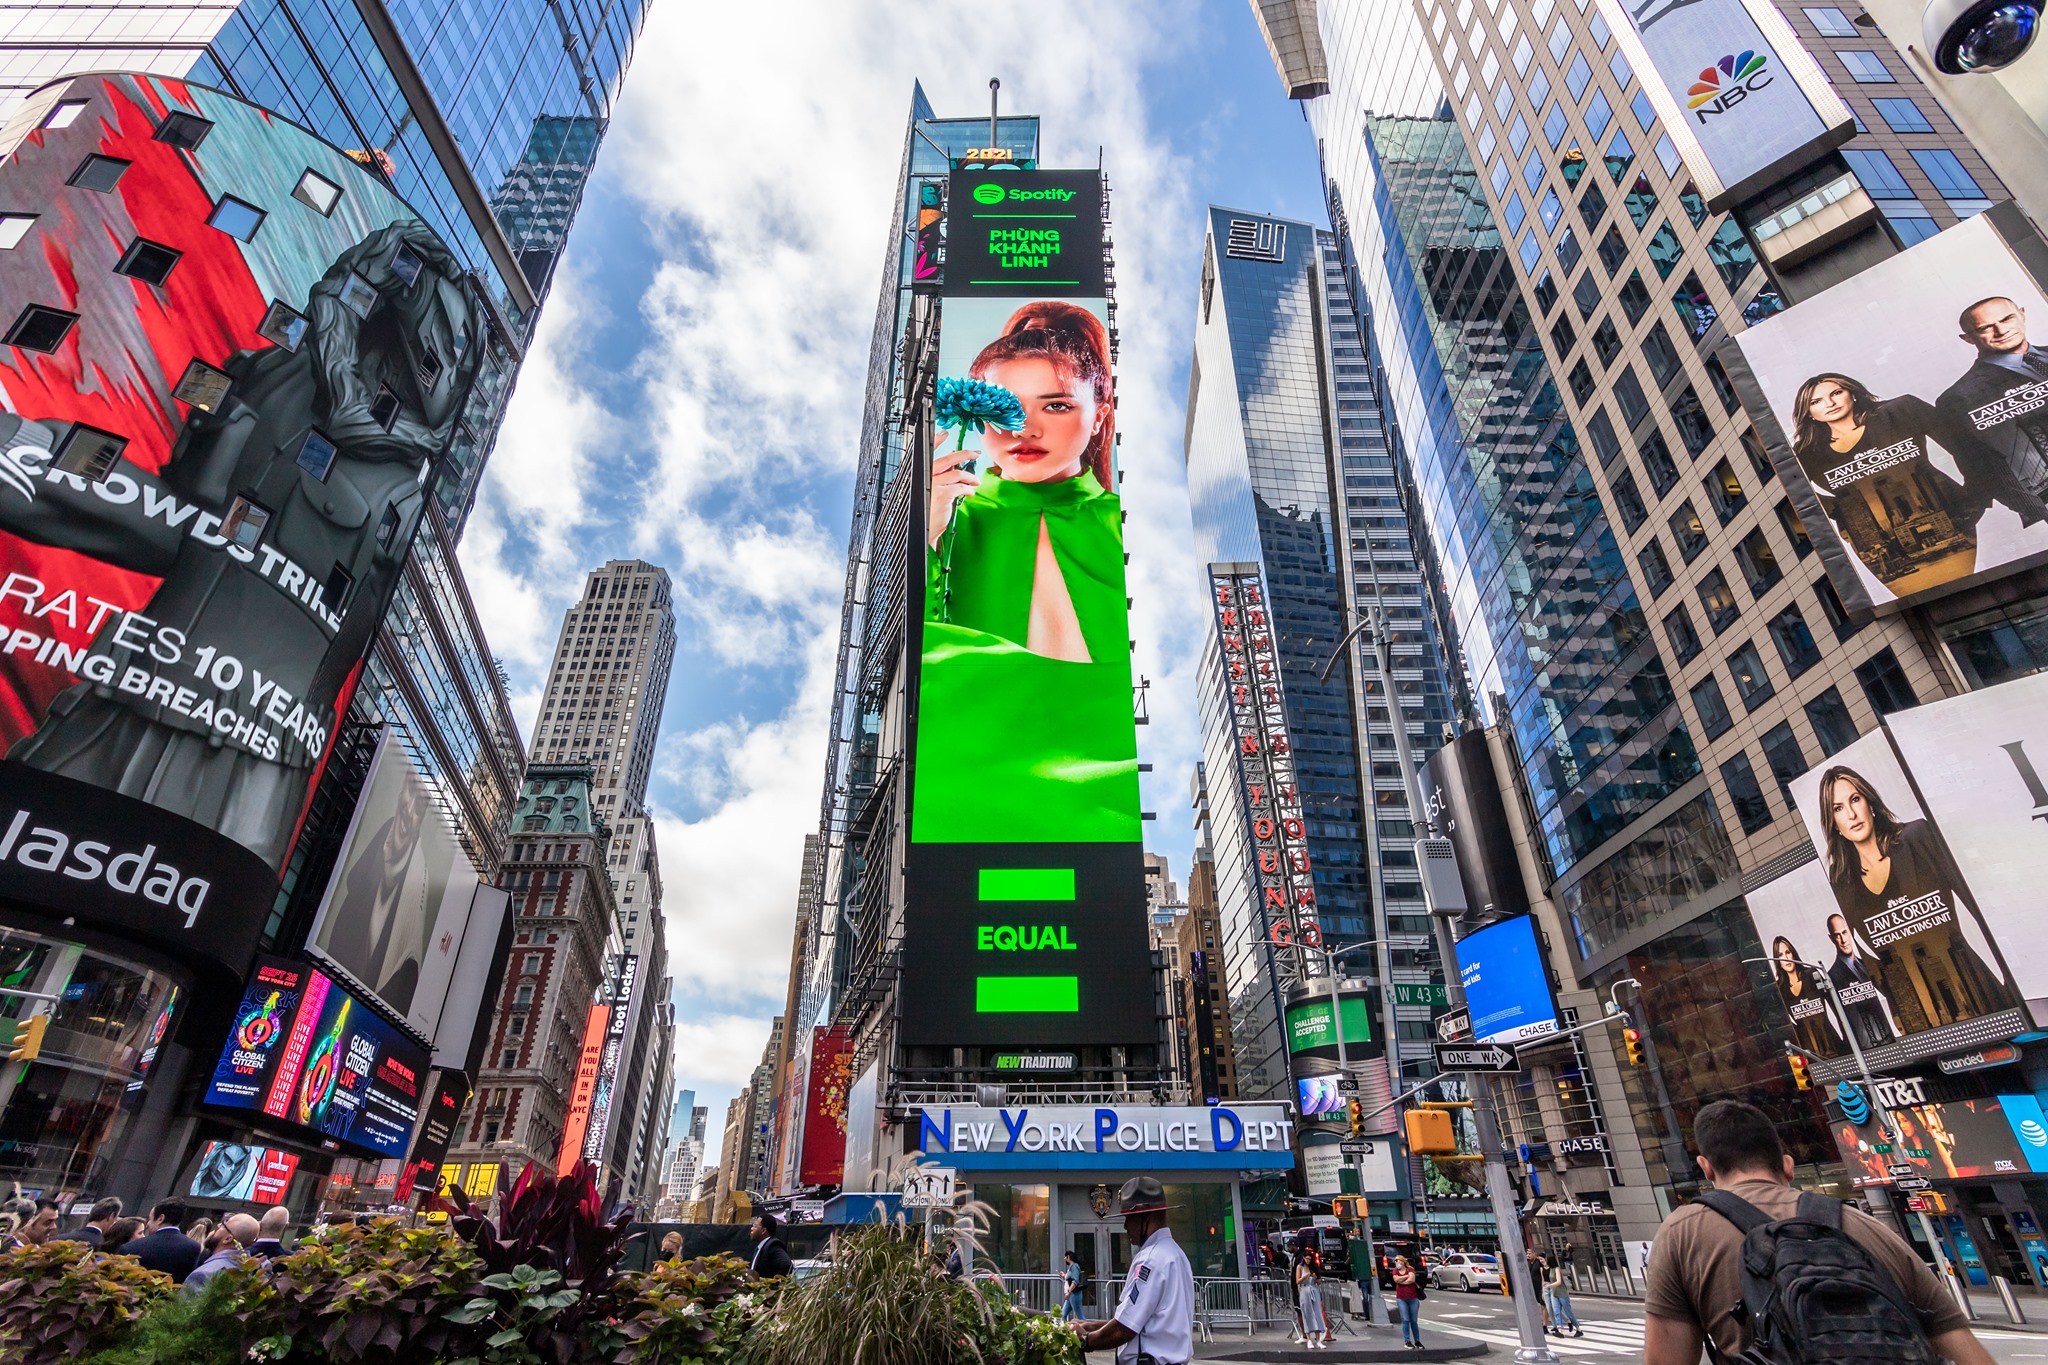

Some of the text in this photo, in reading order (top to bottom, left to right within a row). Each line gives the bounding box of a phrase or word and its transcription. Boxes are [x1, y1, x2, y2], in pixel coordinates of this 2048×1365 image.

[1695, 68, 1775, 125] NBC
[966, 148, 1013, 160] 2021
[1008, 188, 1073, 202] Spotify
[989, 227, 1060, 241] PHÙNG
[988, 241, 1061, 254] KHÁNH
[1001, 256, 1048, 268] LINH
[1969, 383, 2048, 423] LAW & OR
[1976, 399, 2046, 431] ORGANIZED
[1825, 440, 1918, 482] LAW & ORDER
[1829, 449, 1921, 491] SPECIAL VICTIMS UNIT
[193, 645, 245, 691] 10
[249, 669, 327, 760] YEARS
[117, 665, 281, 762] BREACHES
[1219, 586, 1292, 948] ERNST & YOUNG
[1864, 894, 1946, 935] LAW & ORDER
[1872, 911, 1952, 949] SPECIAL VICTIMS UNIT
[977, 925, 1077, 952] EQUAL
[1470, 973, 1482, 985] kids
[1397, 986, 1410, 1002] W
[1416, 986, 1432, 1002] 43
[610, 1003, 628, 1035] Foot
[1294, 1015, 1331, 1029] CHALLENGE
[1440, 1017, 1467, 1034] ONE WAY
[296, 1021, 311, 1035] LIVE
[1295, 1024, 1327, 1037] ACCEPTED
[1519, 1022, 1553, 1038] CHASE
[293, 1031, 307, 1045] LIVE
[289, 1041, 304, 1055] LIVE
[351, 1034, 375, 1062] GLOBAL
[585, 1046, 600, 1054] ARE
[233, 1049, 266, 1063] GLOBAL
[286, 1050, 301, 1064] LIVE
[583, 1056, 598, 1065] YOU
[1448, 1052, 1505, 1064] ONE WAY
[235, 1065, 255, 1075] LIVE
[283, 1060, 297, 1073] LIVE
[580, 1067, 594, 1076] ALL
[280, 1070, 294, 1083] LIVE
[339, 1067, 357, 1090] LIVE
[276, 1080, 290, 1093] LIVE
[581, 1081, 589, 1090] IN
[273, 1090, 287, 1103] LIVE
[577, 1094, 588, 1102] ON
[269, 1100, 283, 1113] LIVE
[572, 1105, 587, 1114] NYC
[575, 1117, 582, 1125] ?
[1332, 1111, 1340, 1119] 43
[919, 1107, 1293, 1152] NEW YORK POLICE DEPT
[1558, 1137, 1602, 1154] CHASE
[763, 1204, 784, 1212] VOLVO
[1544, 1201, 1602, 1215] CHASE
